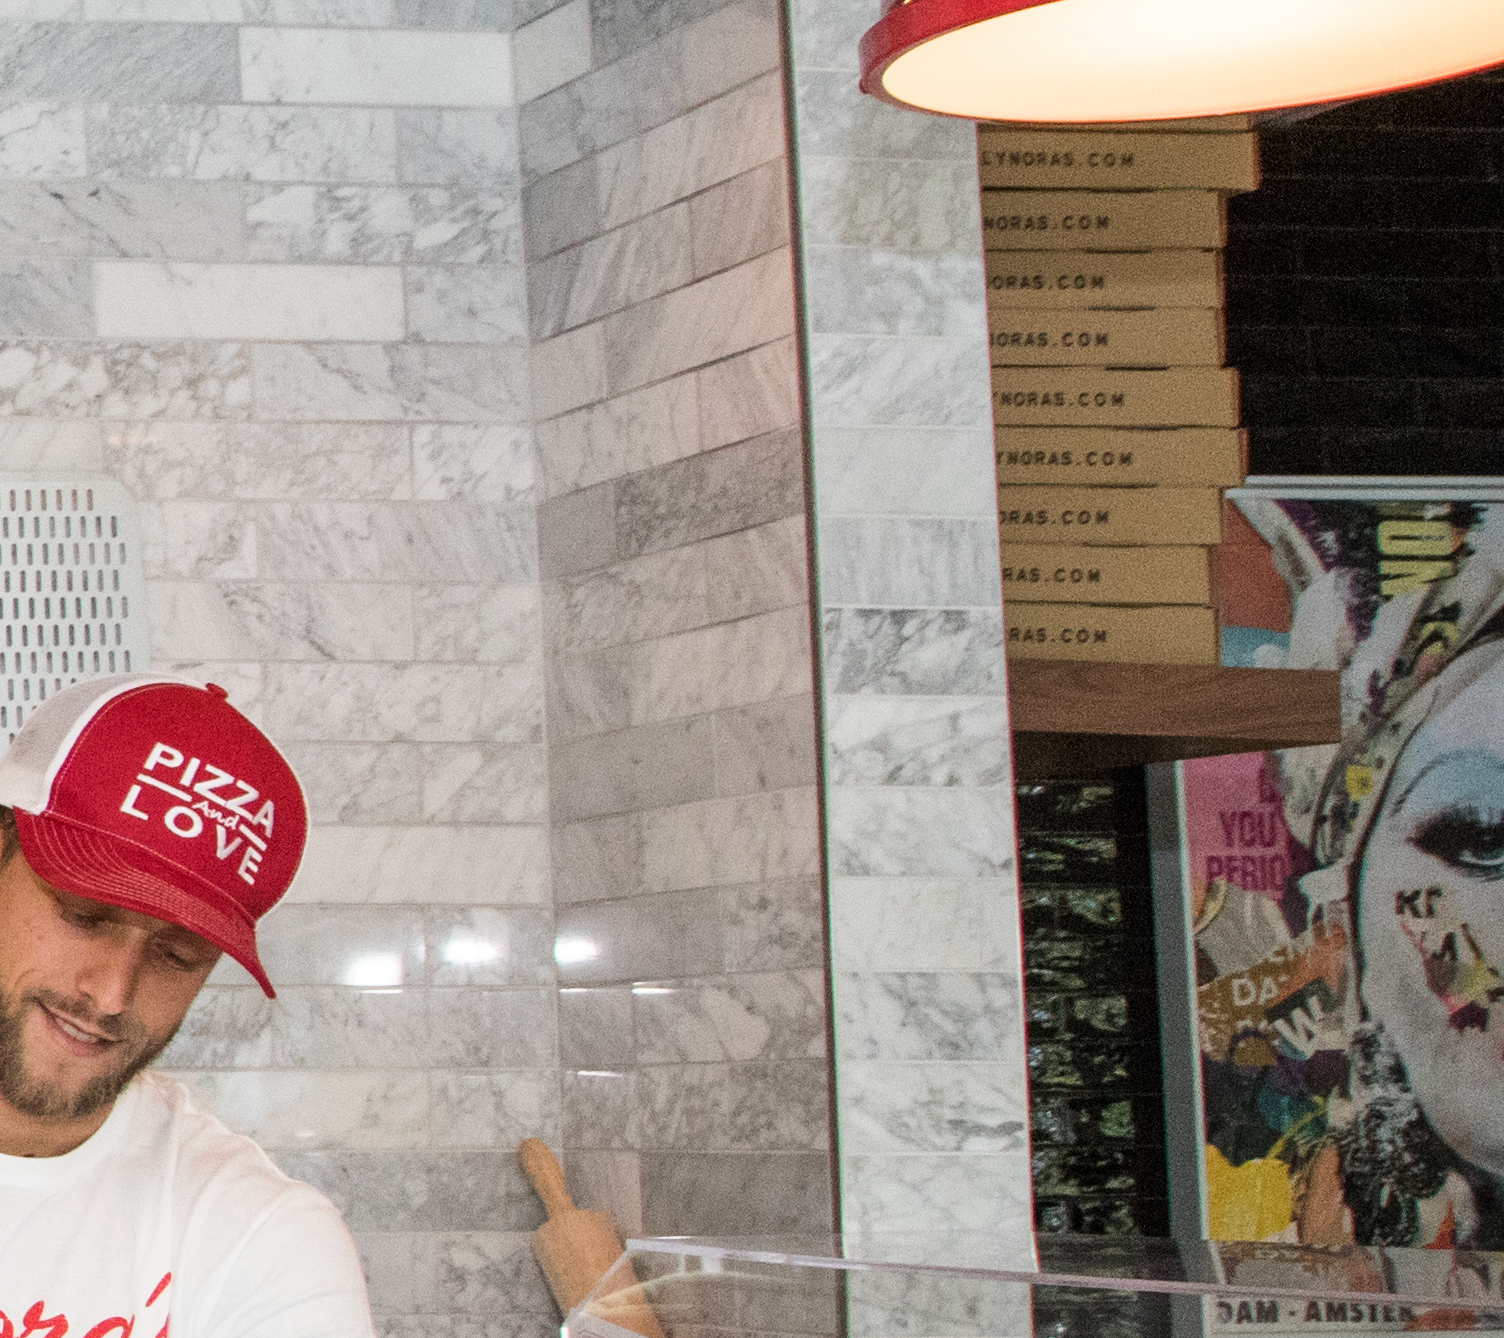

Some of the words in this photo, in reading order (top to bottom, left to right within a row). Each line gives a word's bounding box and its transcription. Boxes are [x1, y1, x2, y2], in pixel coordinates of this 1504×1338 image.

[120, 784, 263, 886] LOVE
[144, 742, 275, 839] PIZZA
[192, 800, 239, 830] And
